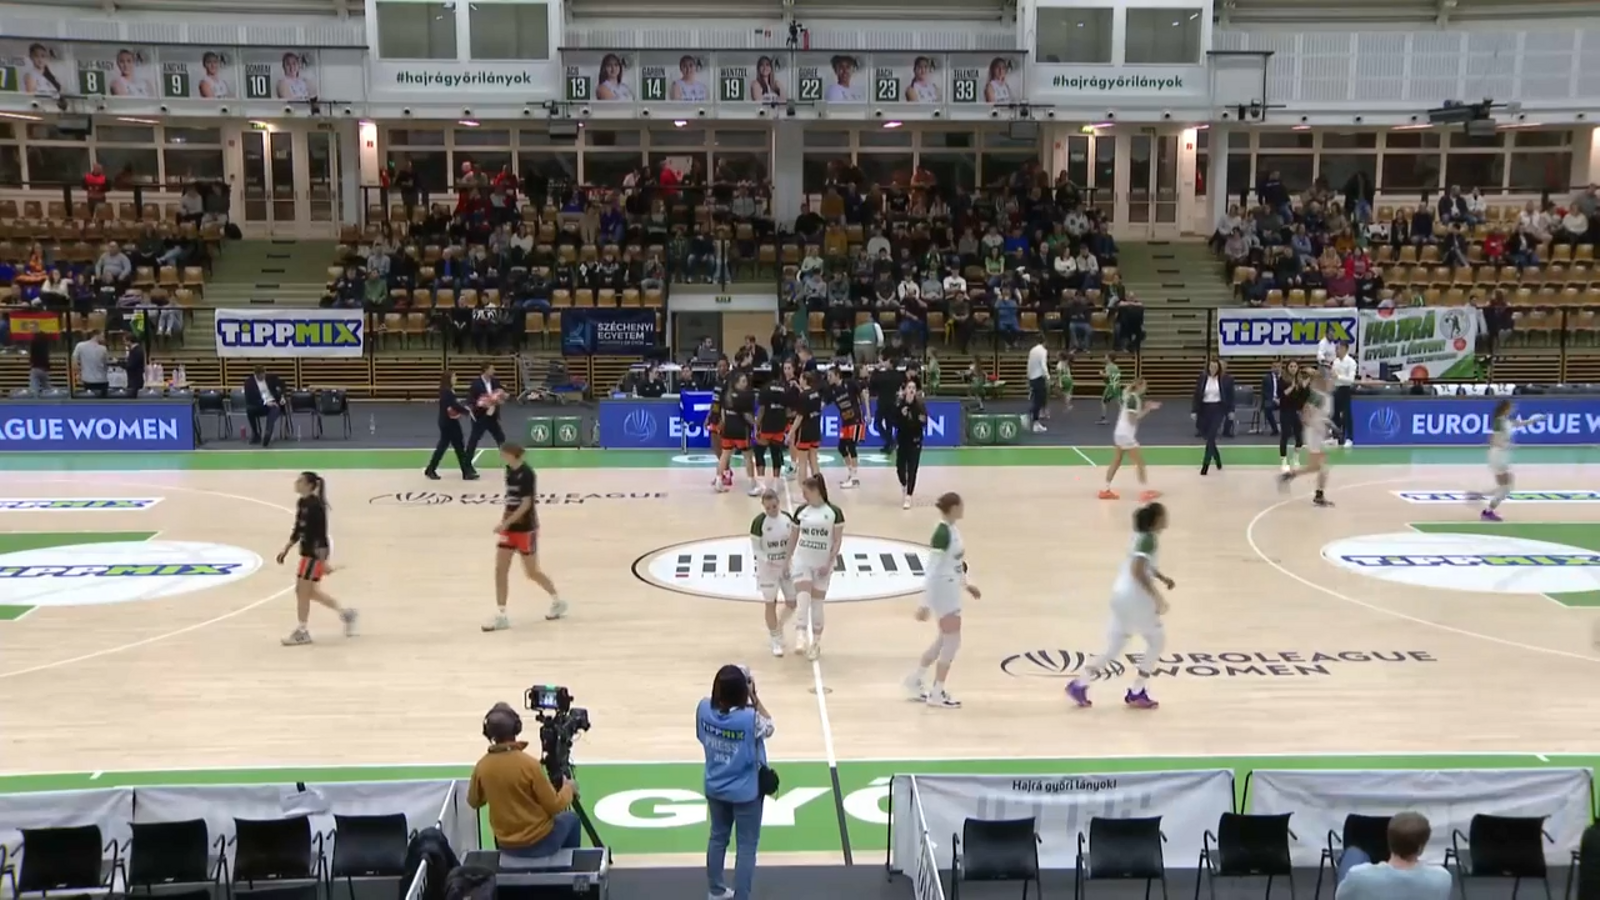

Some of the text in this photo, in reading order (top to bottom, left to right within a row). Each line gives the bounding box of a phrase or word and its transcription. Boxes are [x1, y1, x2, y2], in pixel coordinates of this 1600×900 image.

[86, 72, 97, 92] 8
[171, 74, 182, 95] 9
[250, 75, 266, 96] 10
[571, 78, 586, 98] 13
[646, 78, 662, 98] 14
[724, 79, 740, 99] 19
[801, 79, 819, 100] 22
[878, 80, 897, 99] 23
[956, 80, 974, 100] 33
[597, 321, 654, 332] SZÉCHENYI
[597, 332, 645, 340] EGYETEM
[68, 418, 178, 440] WOMEN
[1412, 413, 1581, 434] EUROLAGUE
[1138, 665, 1332, 677] WOMEN
[1012, 779, 1117, 793] Hajrá győri lányok!
